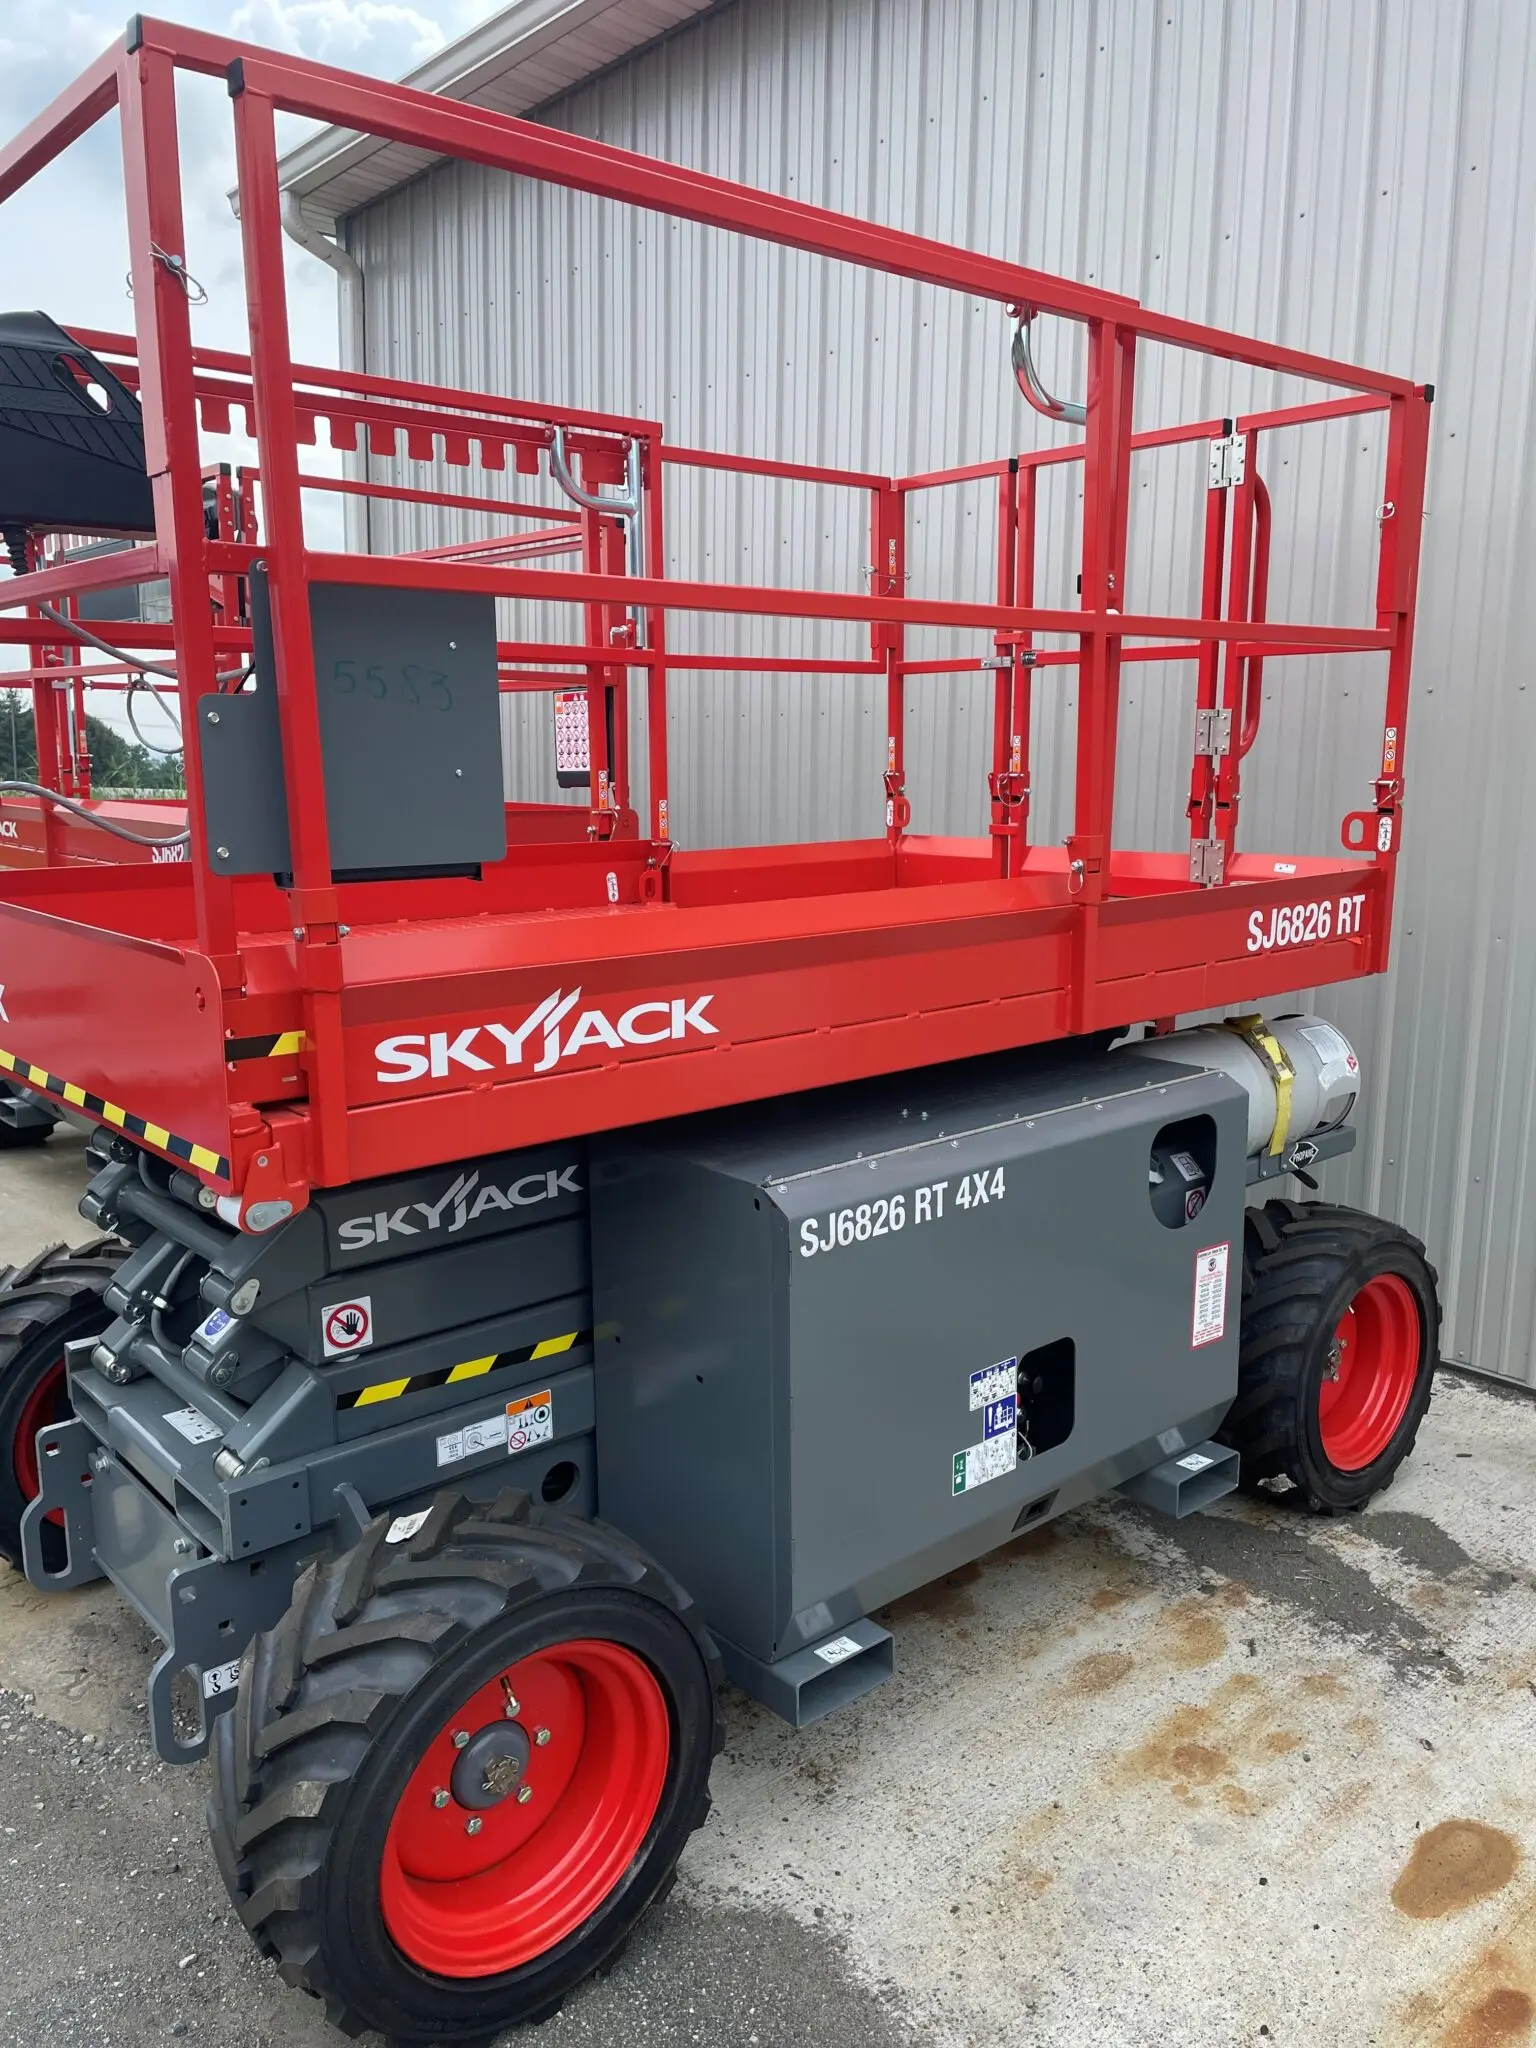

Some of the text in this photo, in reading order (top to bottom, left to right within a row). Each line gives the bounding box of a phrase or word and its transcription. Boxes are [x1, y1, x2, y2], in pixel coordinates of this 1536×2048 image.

[1246, 894, 1366, 951] SJ6826 RT
[374, 986, 720, 1083] SKYJACK
[338, 1164, 584, 1250] SKYJACK
[800, 1166, 1006, 1258] SJ6826 RT 4X4
